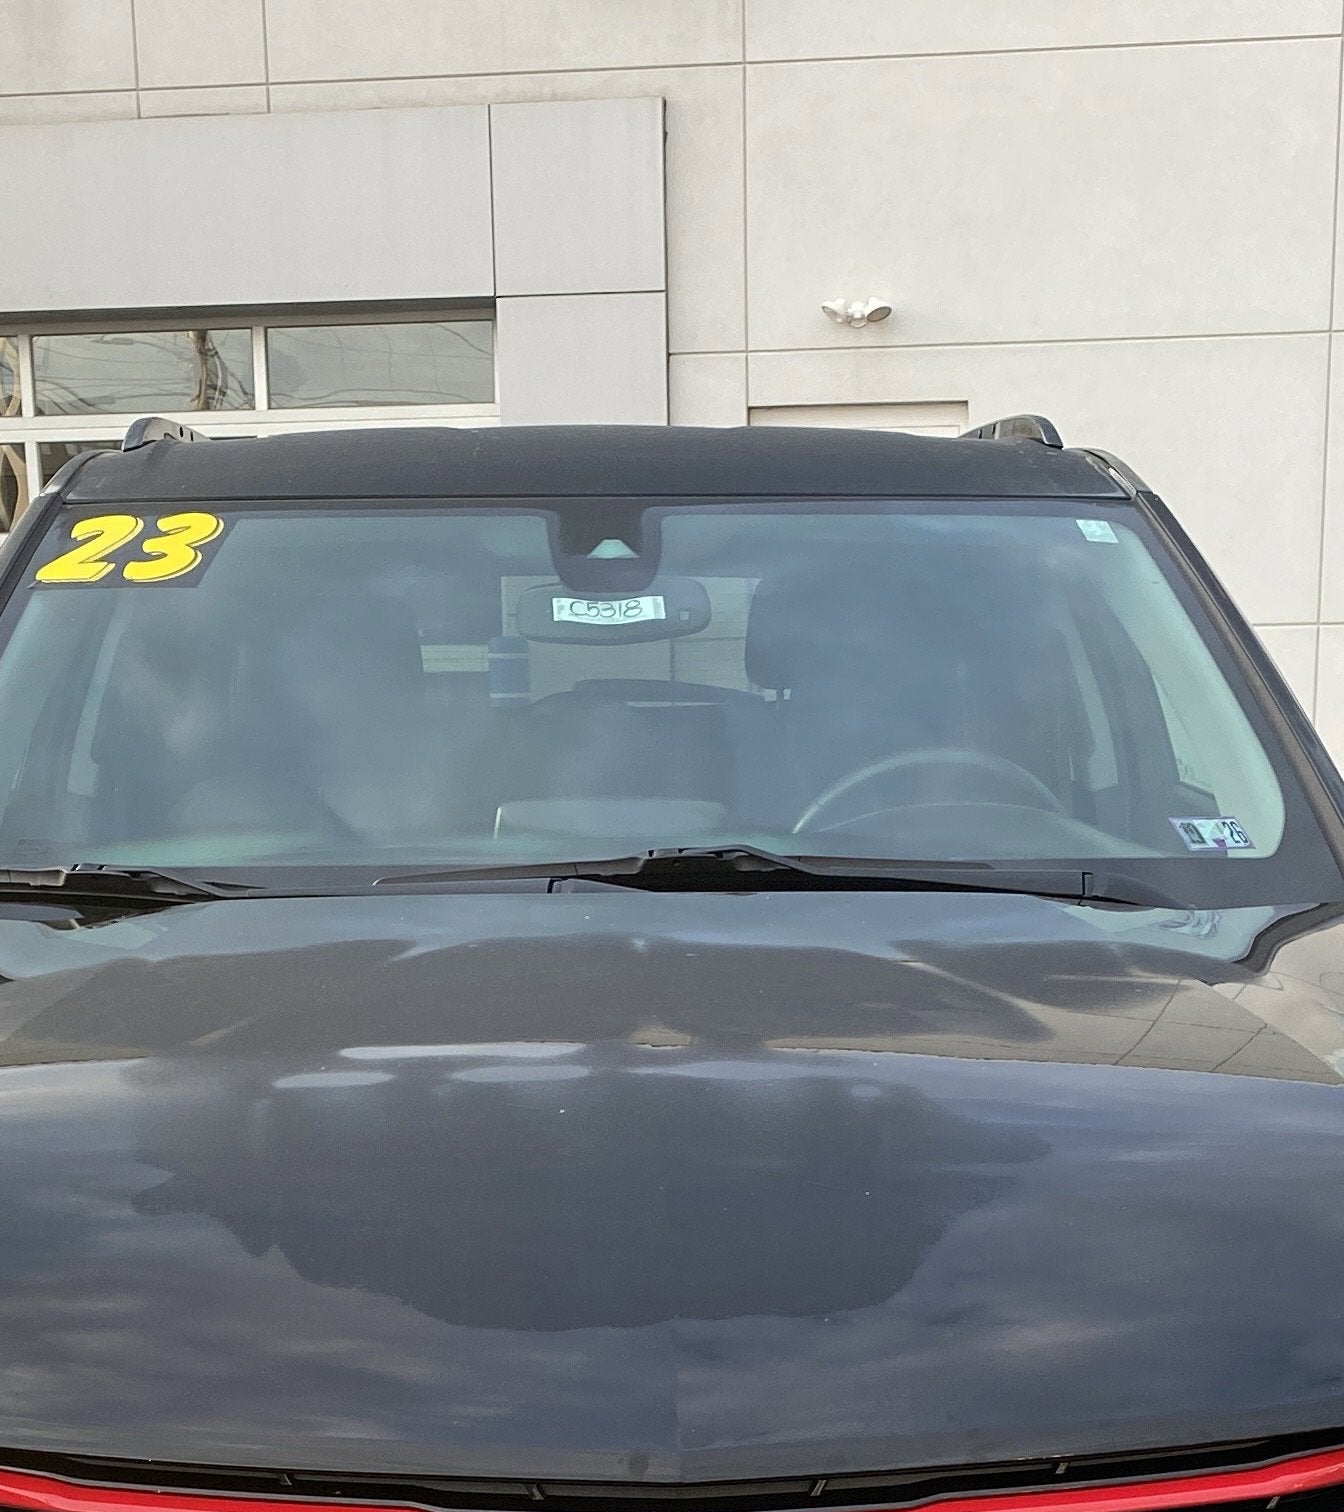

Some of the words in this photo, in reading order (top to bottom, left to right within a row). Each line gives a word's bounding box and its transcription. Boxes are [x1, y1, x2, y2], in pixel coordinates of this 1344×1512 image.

[35, 512, 225, 583] 23
[568, 599, 644, 618] C5318
[1221, 821, 1249, 844] 26
